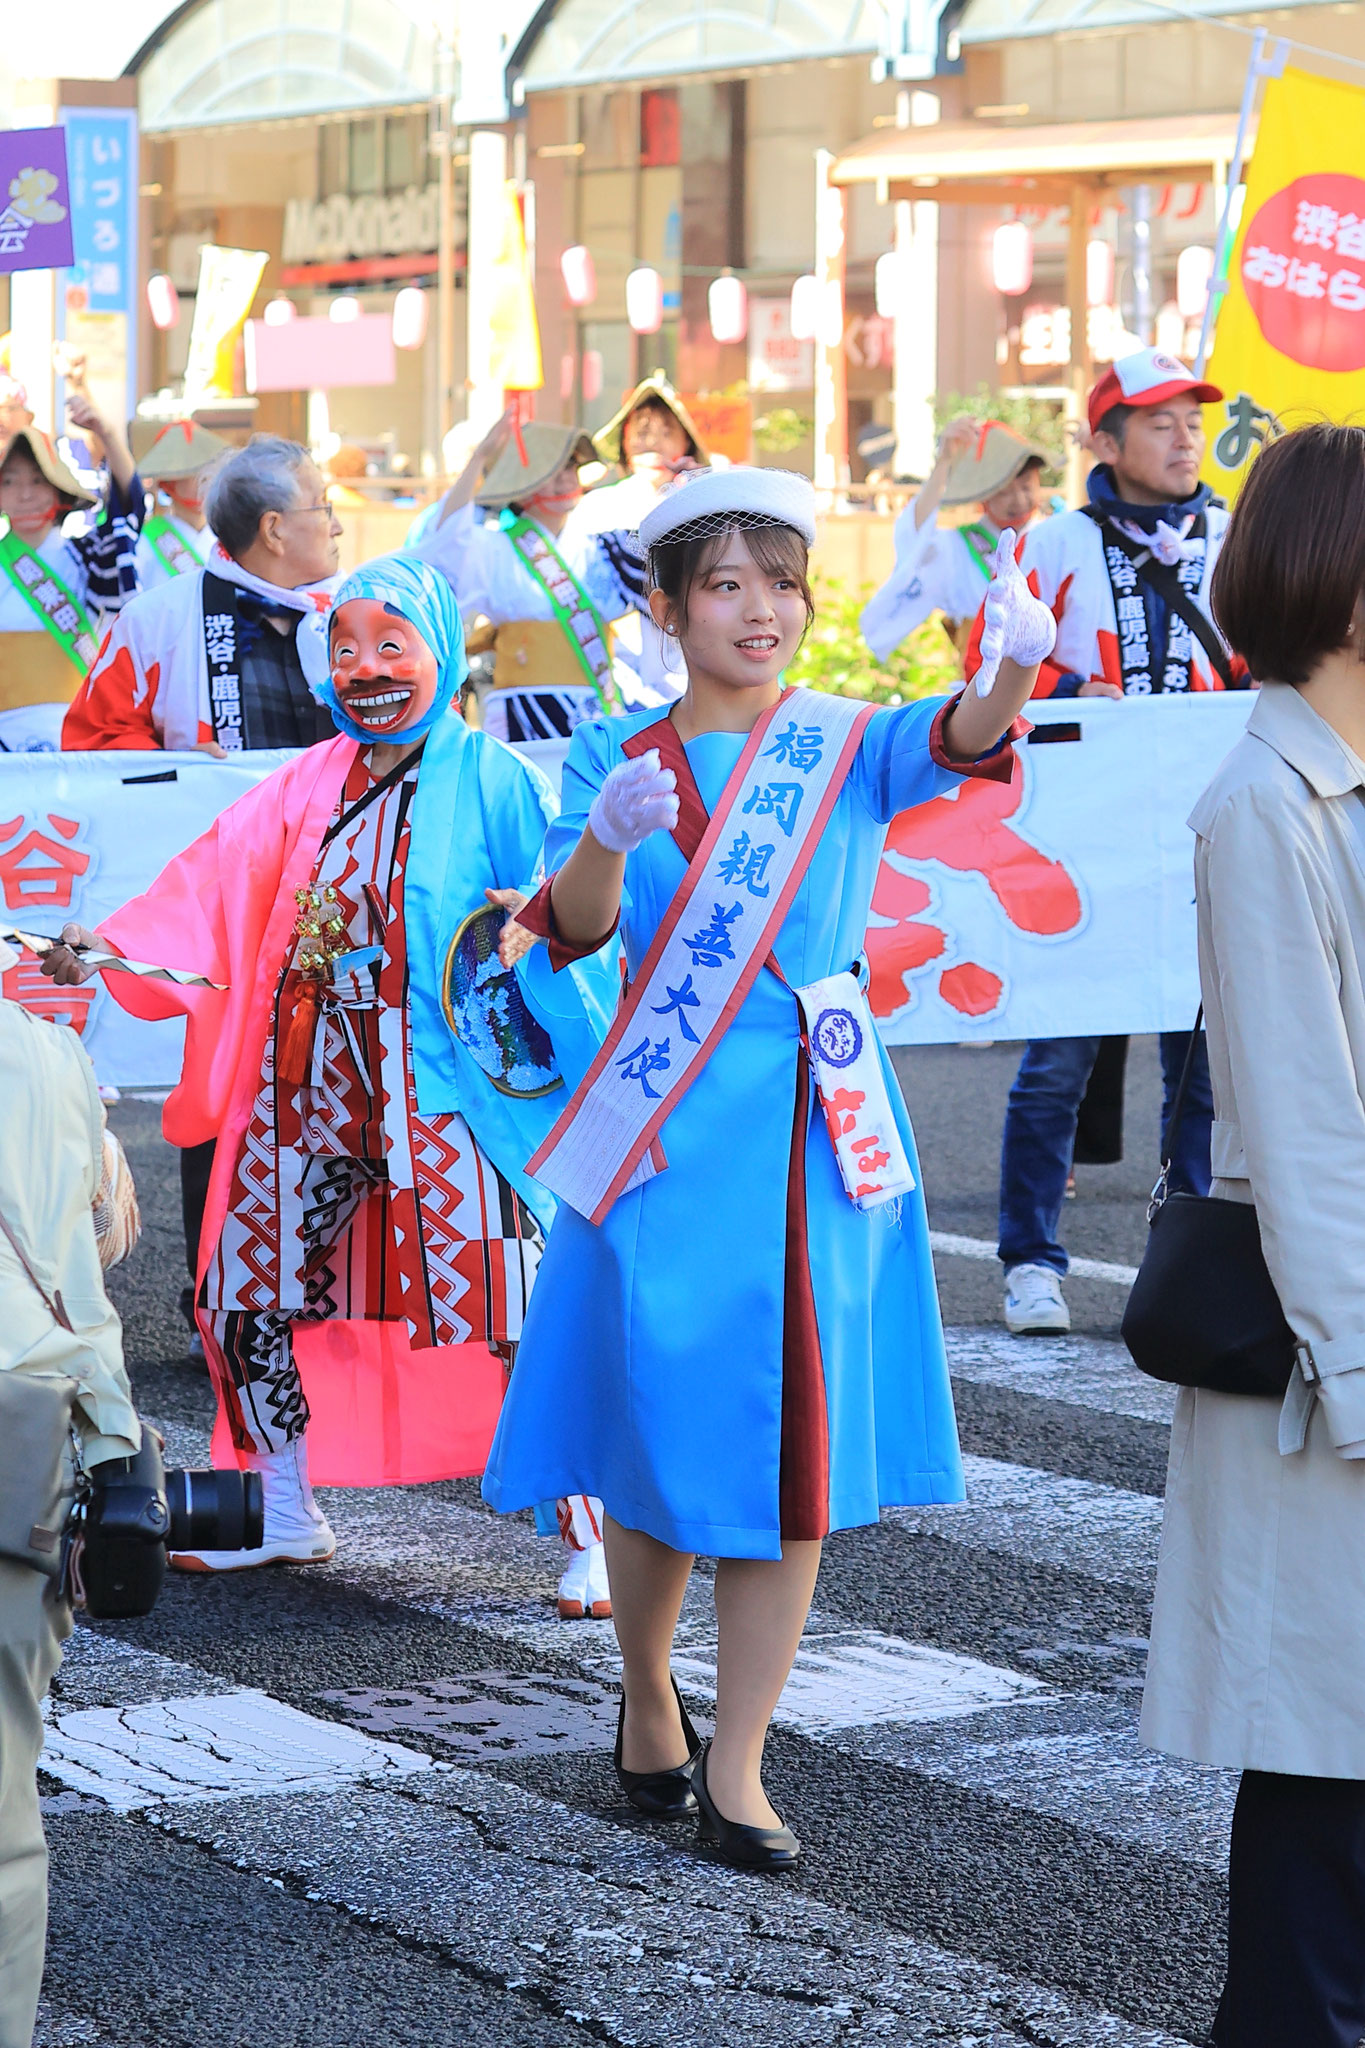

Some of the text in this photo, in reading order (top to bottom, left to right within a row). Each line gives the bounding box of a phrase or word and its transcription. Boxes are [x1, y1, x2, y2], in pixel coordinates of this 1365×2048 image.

[1243, 246, 1365, 313] おはら
[616, 721, 824, 1099] 福岡親善大使
